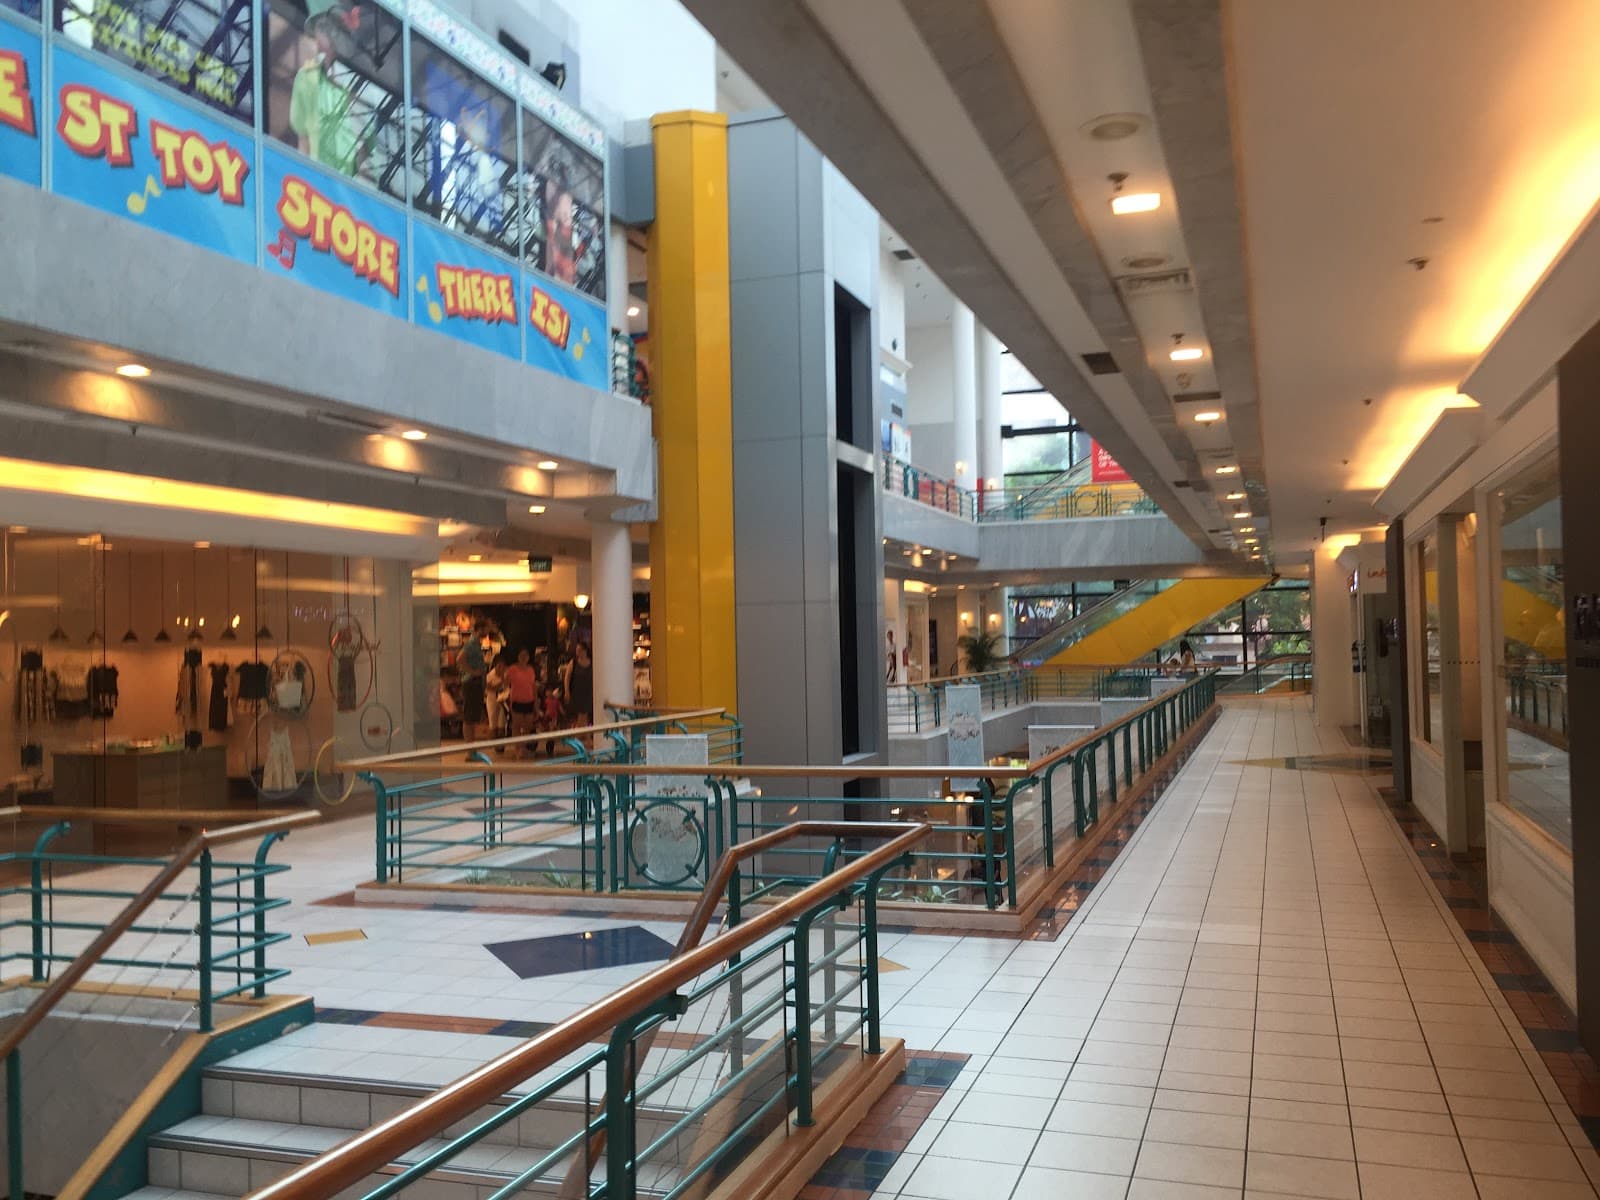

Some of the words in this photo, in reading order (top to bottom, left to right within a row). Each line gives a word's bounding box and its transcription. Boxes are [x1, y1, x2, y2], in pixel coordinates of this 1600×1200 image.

[151, 120, 247, 204] TOY
[278, 175, 398, 295] STORE
[436, 263, 516, 324] THERE
[531, 287, 570, 348] IS!
